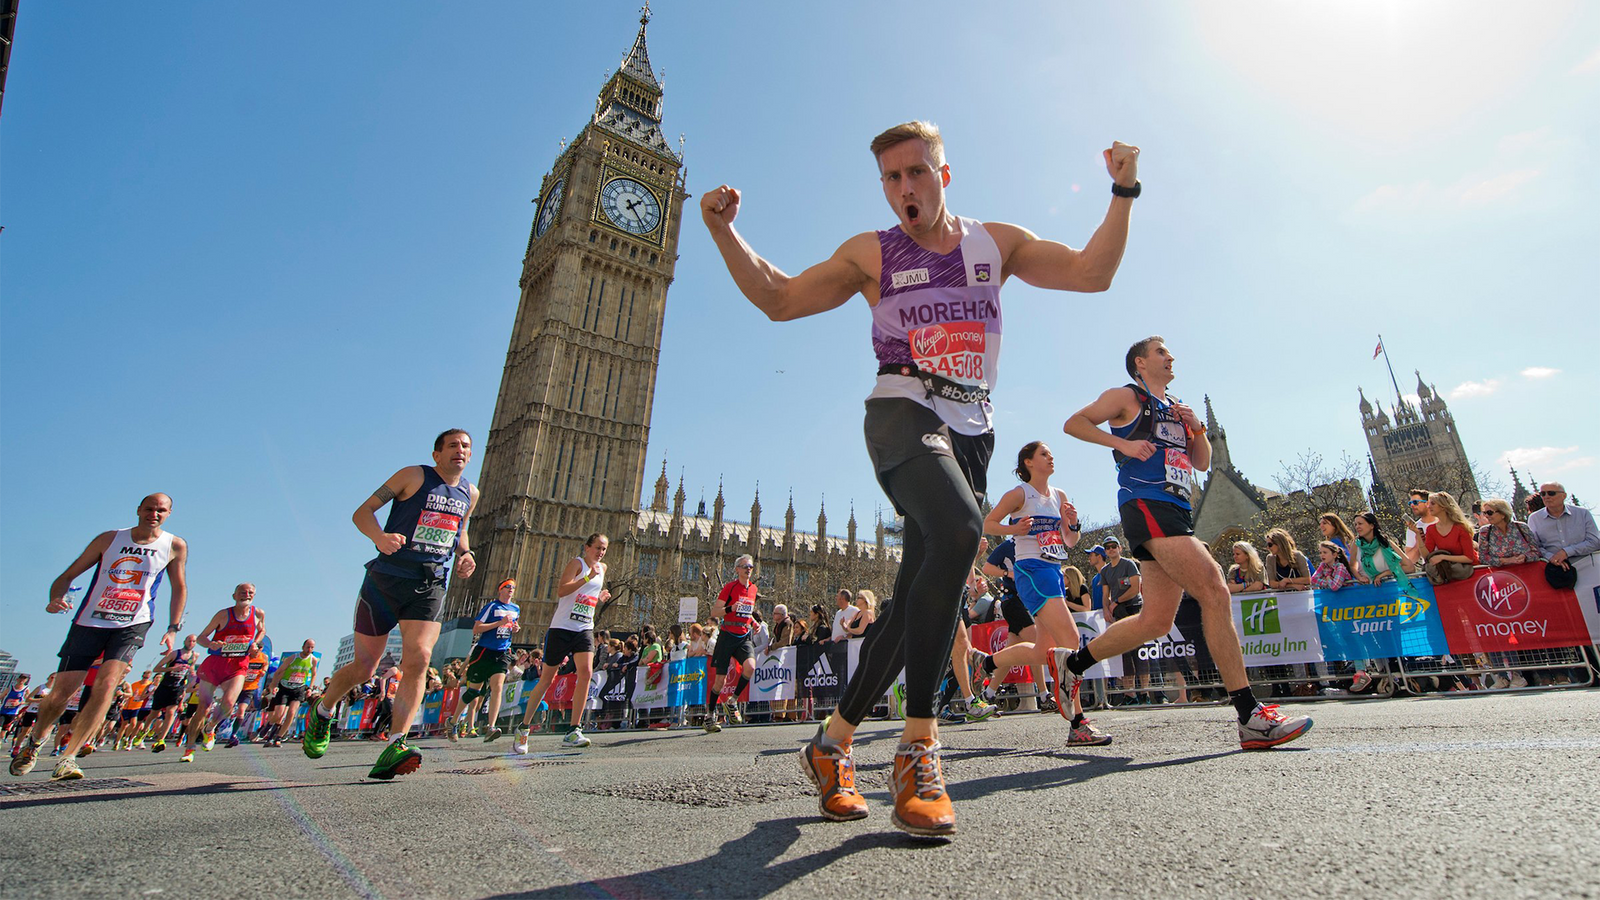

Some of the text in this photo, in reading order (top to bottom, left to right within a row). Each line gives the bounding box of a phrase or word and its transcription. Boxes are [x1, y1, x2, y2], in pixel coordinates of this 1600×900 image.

[903, 272, 928, 285] JMU
[899, 300, 997, 327] MOREHEN
[916, 328, 984, 355] Virgin money
[919, 353, 983, 380] 34508
[425, 502, 466, 517] RUNNERS
[427, 494, 467, 508] DIDCOT
[415, 526, 455, 543] 28837
[119, 546, 157, 556] MATT
[1481, 576, 1522, 610] Virgin
[98, 599, 139, 613] 48560
[1322, 599, 1412, 623] Lucozade
[1351, 619, 1394, 636] Sport
[1475, 619, 1548, 638] money
[1138, 642, 1196, 660] adidas
[1284, 637, 1306, 652] Inn
[754, 664, 792, 684] Buxton
[804, 674, 839, 688] adidas
